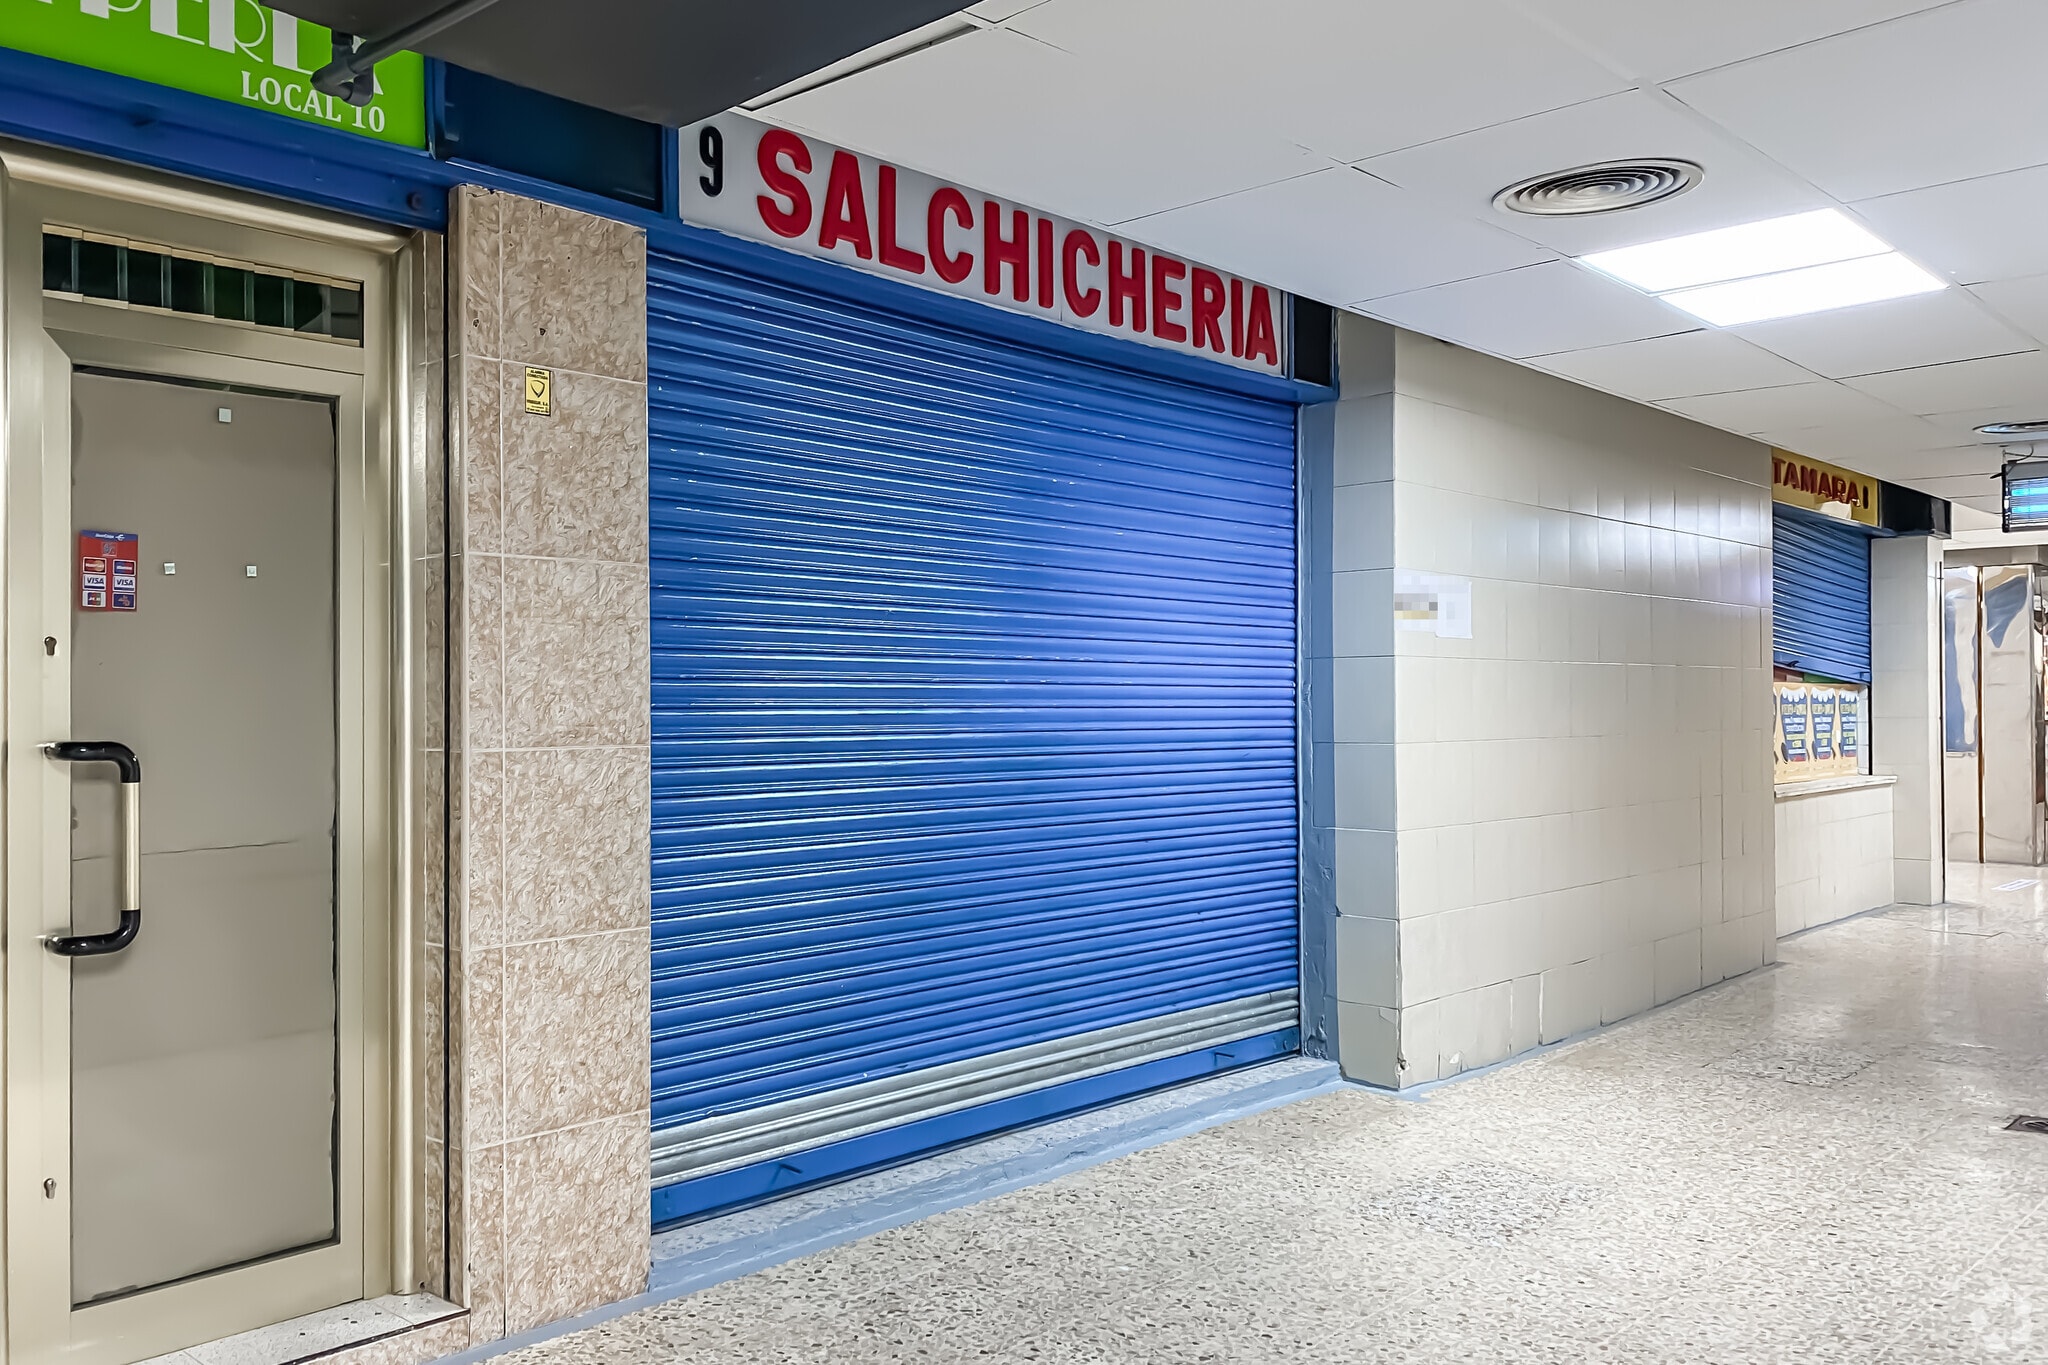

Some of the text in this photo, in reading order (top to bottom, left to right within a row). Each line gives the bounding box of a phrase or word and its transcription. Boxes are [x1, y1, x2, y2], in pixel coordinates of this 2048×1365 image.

[240, 70, 386, 133] LOCAL 10
[698, 125, 1279, 367] 9 SALCHICHERIA
[1772, 456, 1861, 508] TAMARA
